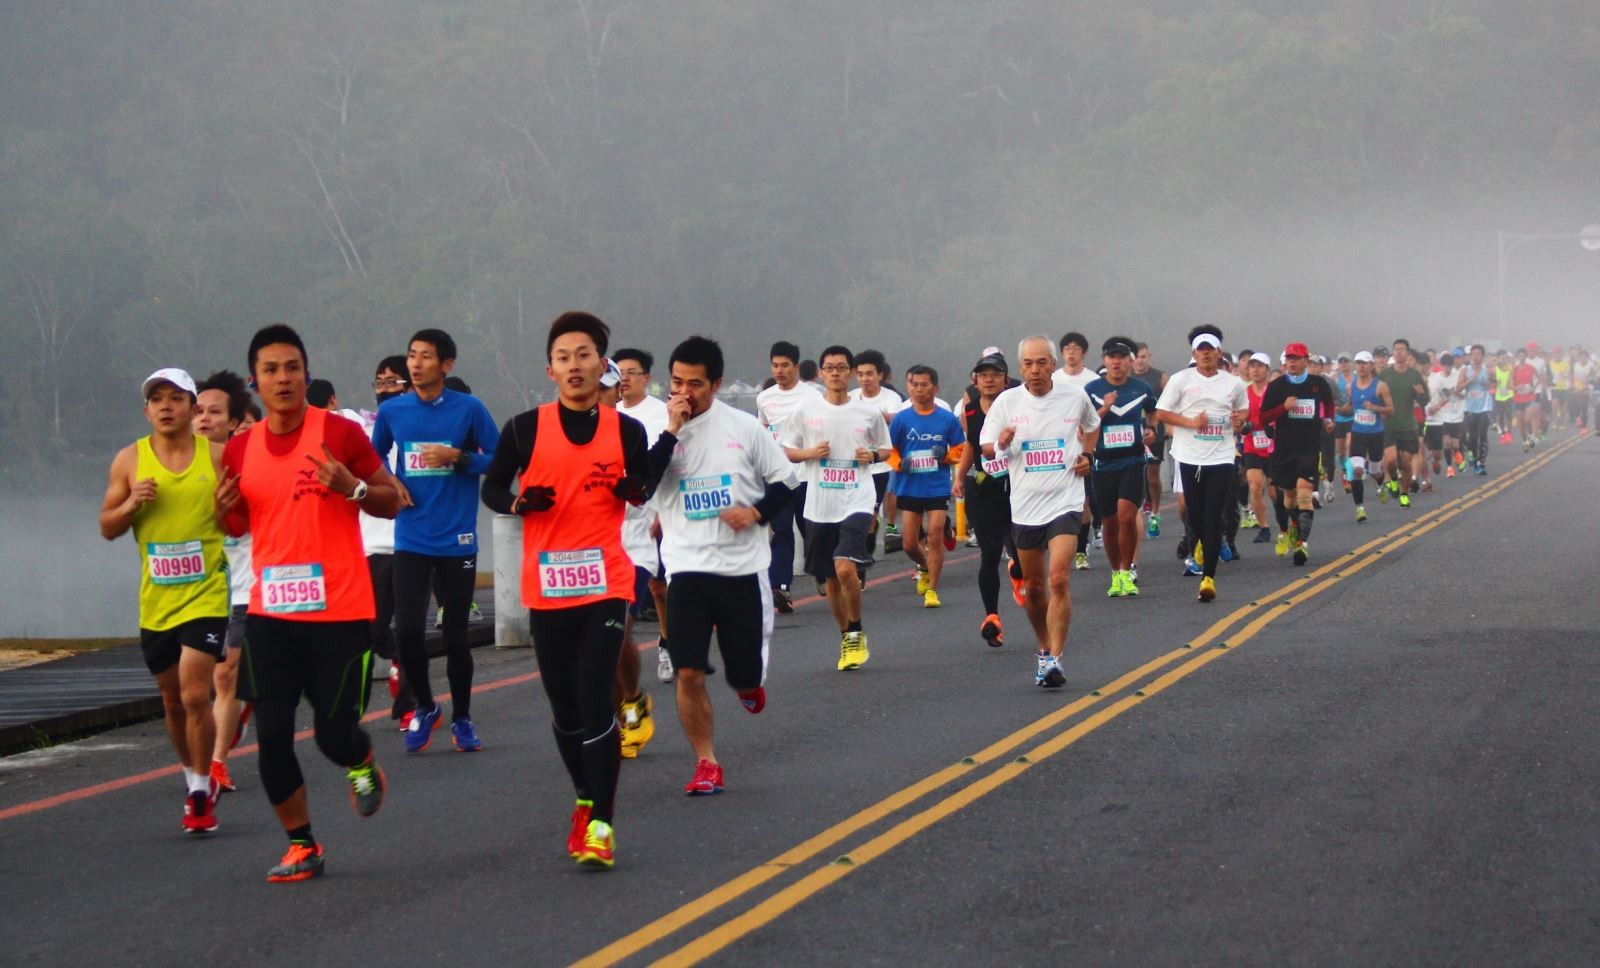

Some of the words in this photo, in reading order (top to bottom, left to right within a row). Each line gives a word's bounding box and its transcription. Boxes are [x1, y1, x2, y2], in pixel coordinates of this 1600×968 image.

[1105, 431, 1133, 444] 30445
[1026, 449, 1064, 466] 00022
[823, 468, 856, 482] 30734
[684, 488, 732, 511] A0905
[152, 554, 203, 577] 30990
[552, 551, 573, 562] 2014
[546, 563, 601, 588] 31595
[268, 580, 320, 604] 31596
